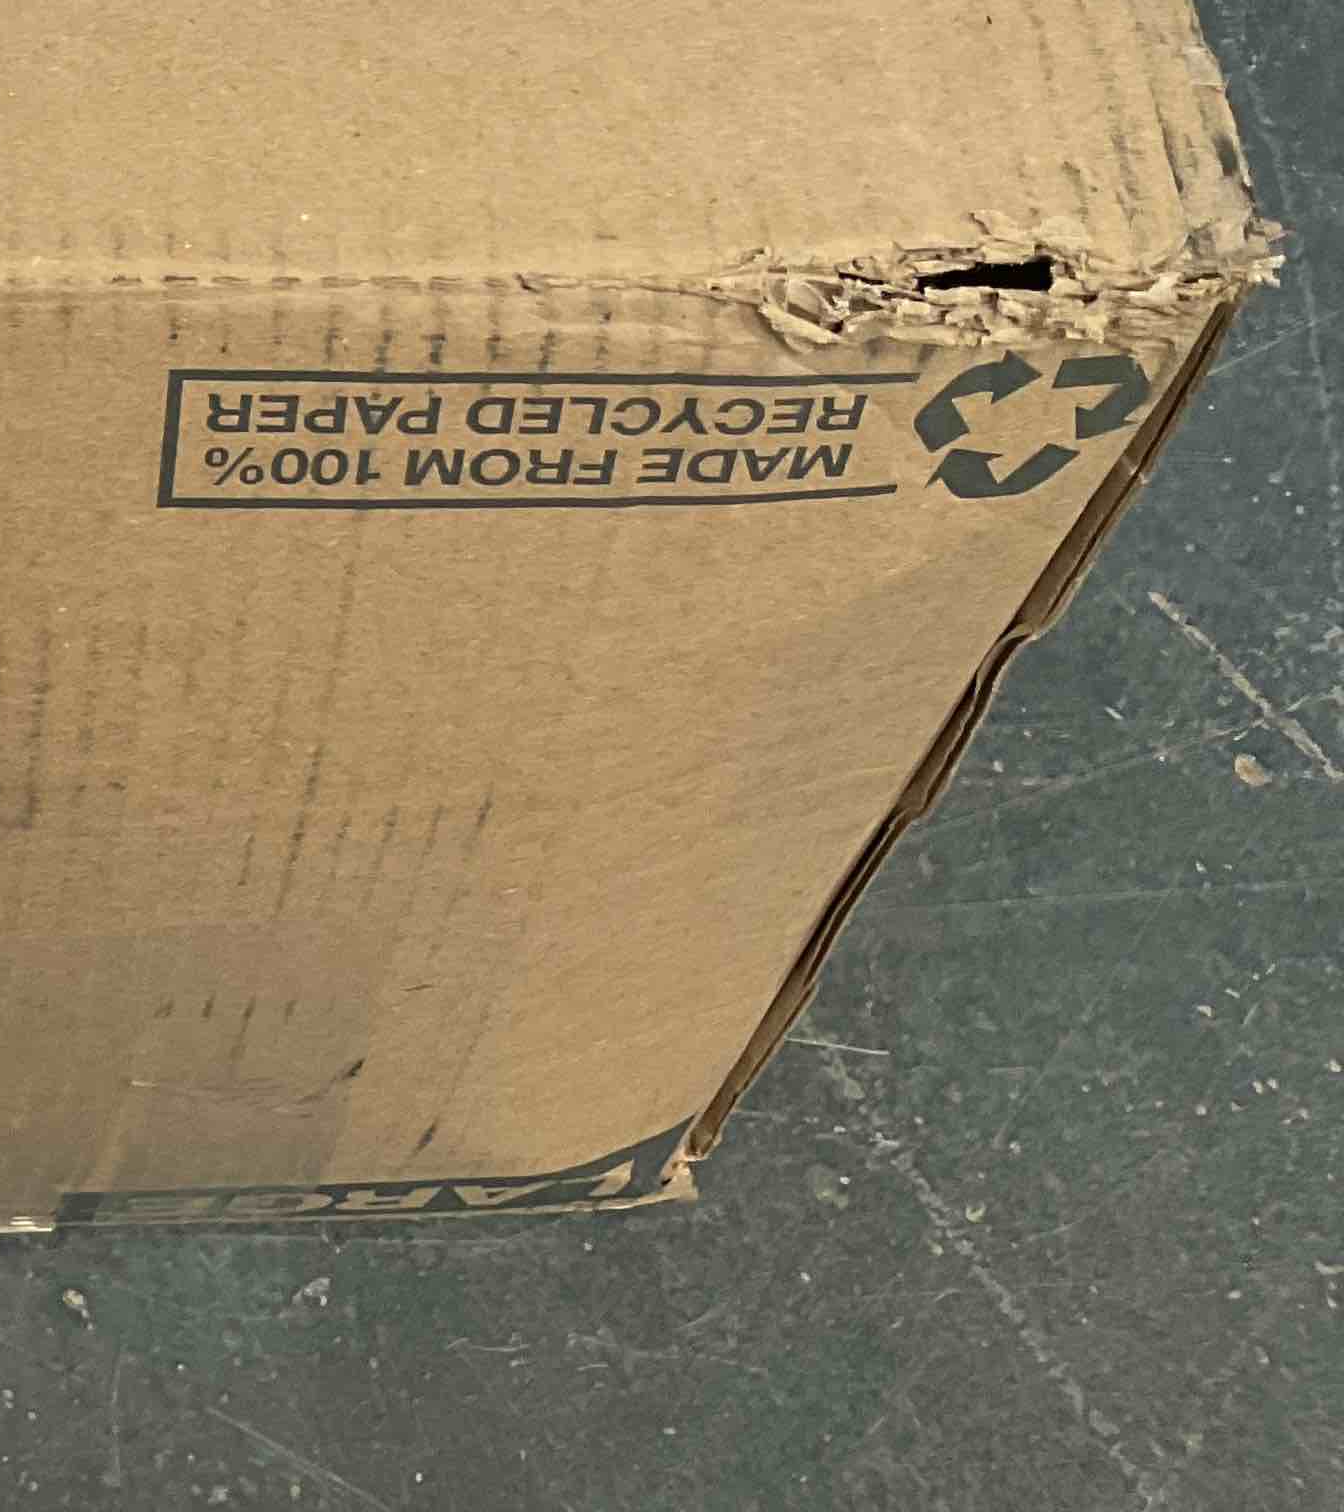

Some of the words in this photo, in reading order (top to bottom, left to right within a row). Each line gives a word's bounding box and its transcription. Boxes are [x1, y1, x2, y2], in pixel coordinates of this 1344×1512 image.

[207, 393, 443, 435] PAPER
[466, 394, 867, 437] RECYCLED
[205, 449, 384, 486] 100%
[404, 449, 617, 486] FROM
[642, 443, 853, 481] MADE
